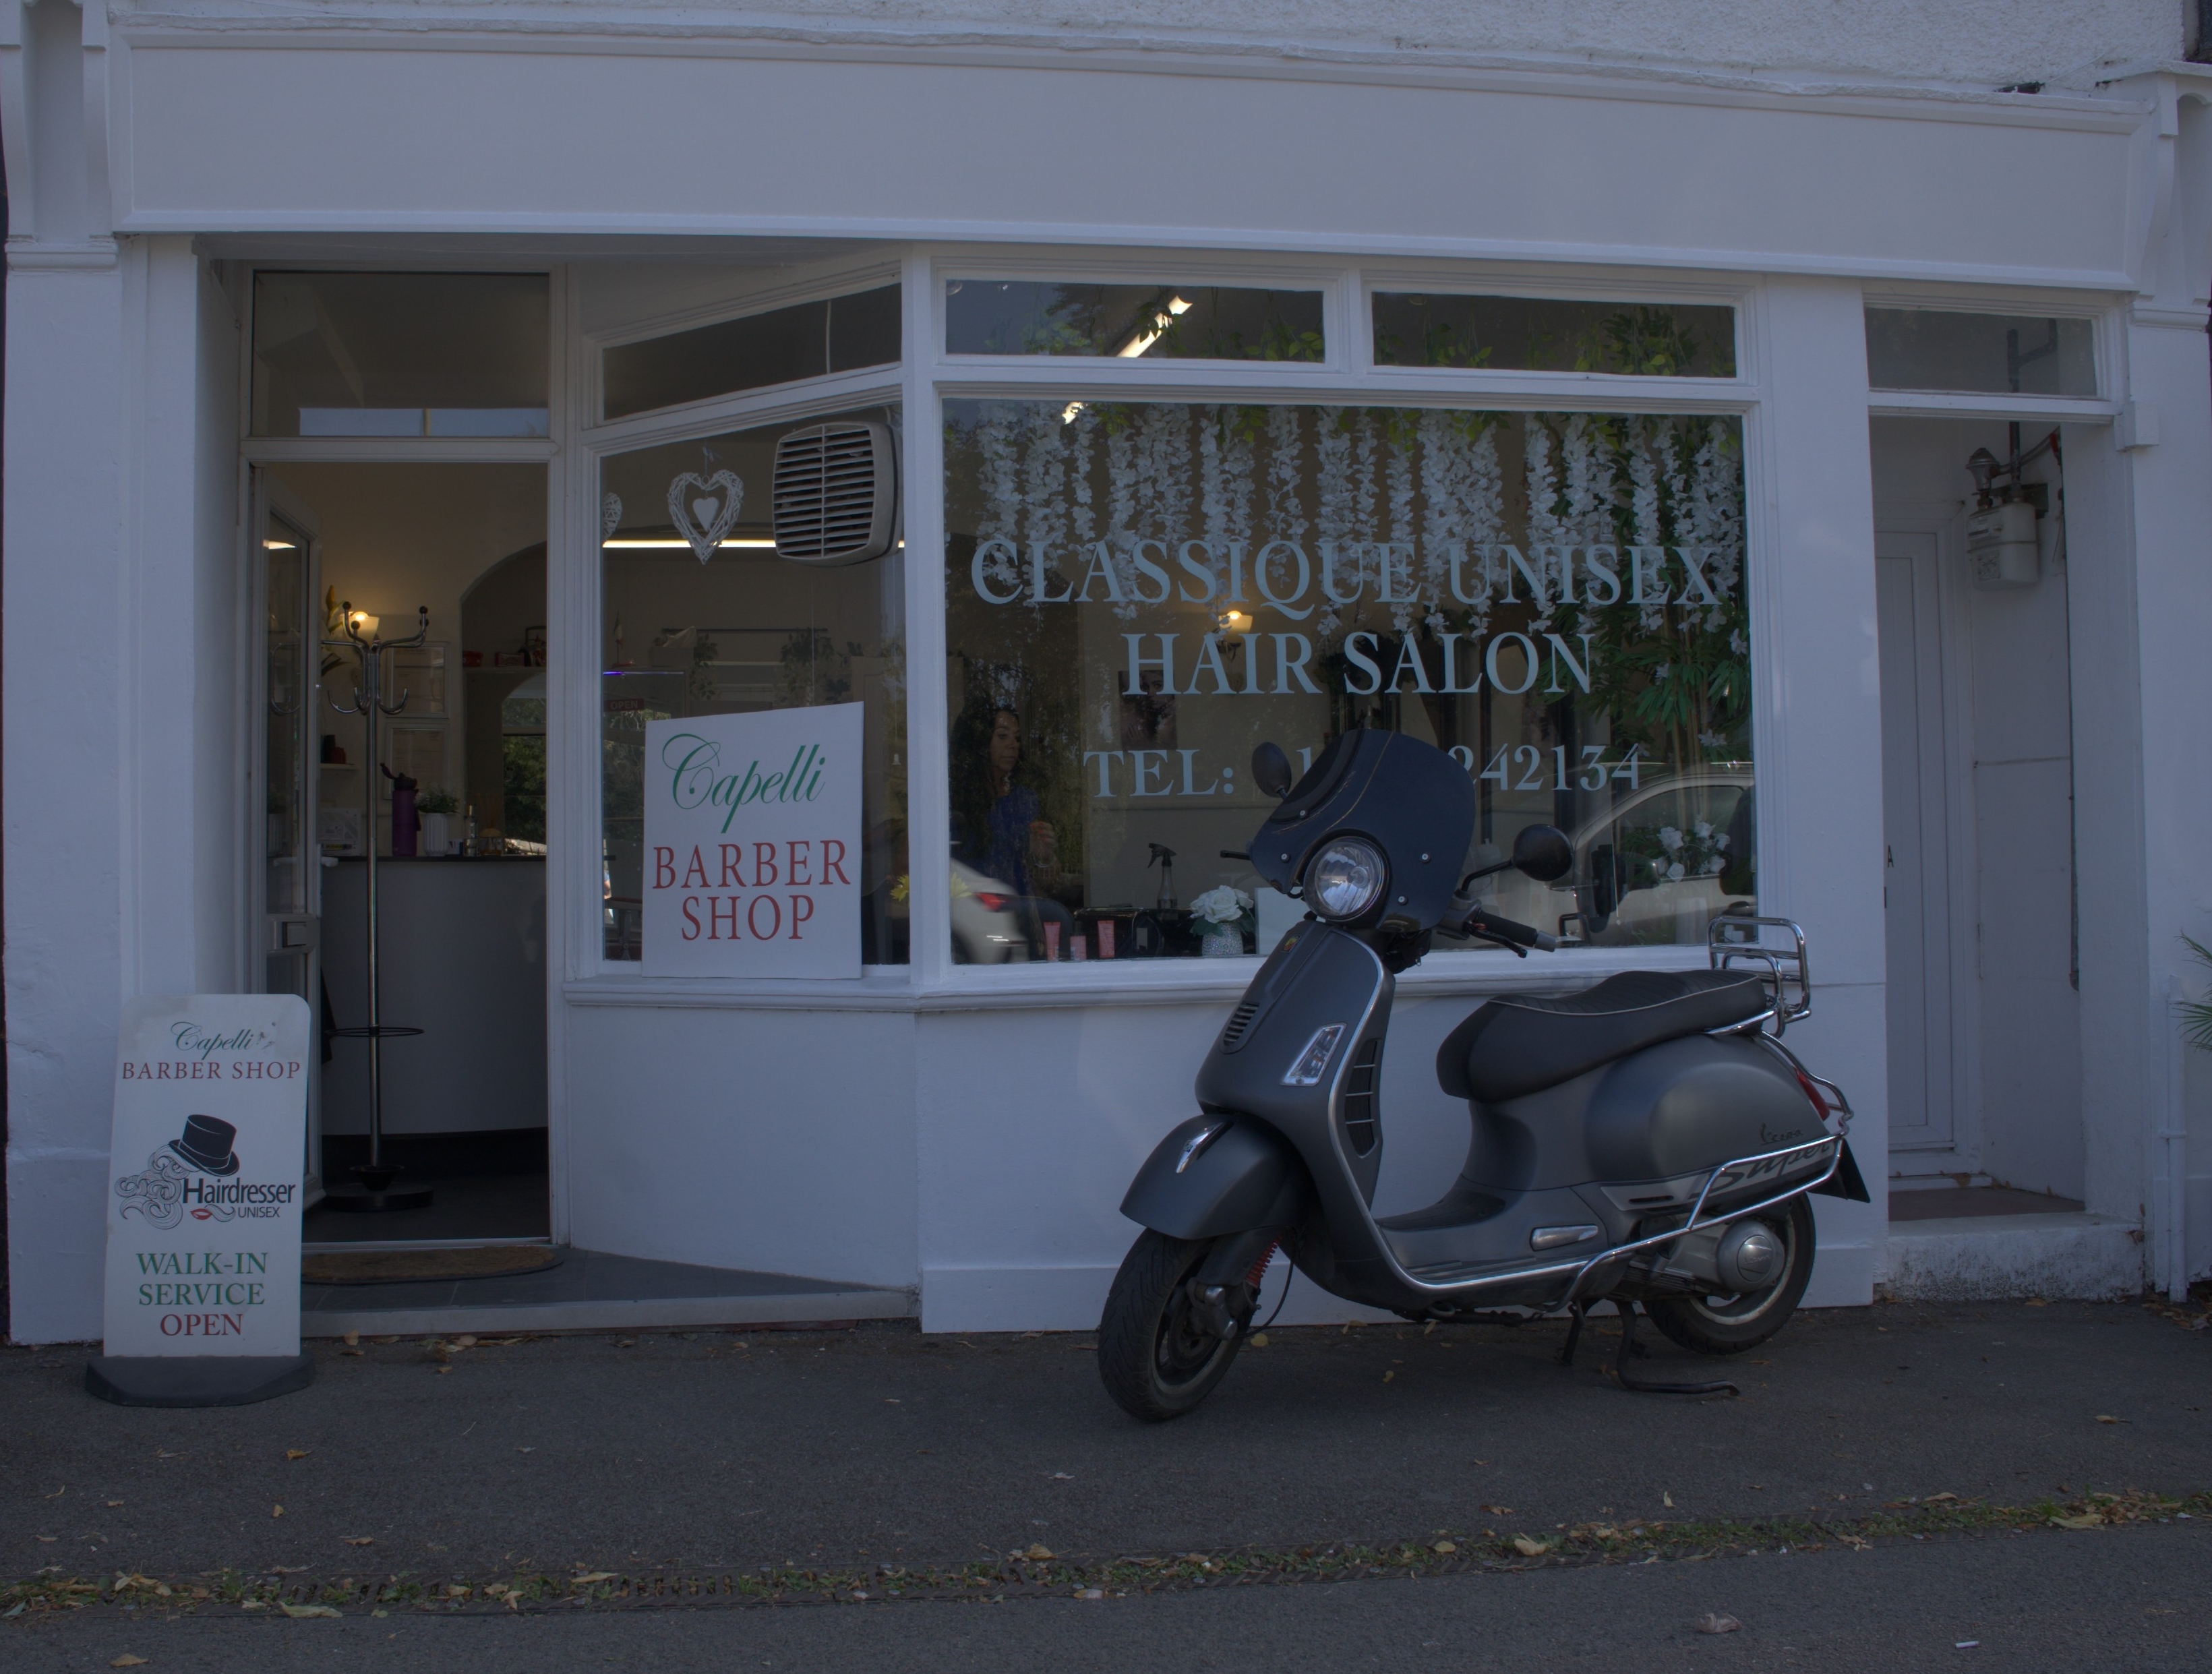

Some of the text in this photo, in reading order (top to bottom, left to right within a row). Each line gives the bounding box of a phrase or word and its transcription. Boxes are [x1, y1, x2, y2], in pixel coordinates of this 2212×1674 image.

[971, 539, 1723, 621] CLASSIQUE UNISEX
[1120, 632, 1596, 696] HAIR SALON
[609, 700, 638, 710] OPEN
[662, 734, 827, 834] Capelli
[1083, 748, 1235, 798] TEL:
[653, 839, 851, 889] BARBER
[682, 895, 814, 941] SHOP
[171, 1021, 254, 1060] Capelli
[123, 1061, 301, 1080] BARBER SHOP
[183, 1177, 296, 1204] Hairdresser
[237, 1207, 280, 1218] UNISEX
[136, 1253, 268, 1275] WALK-IN
[139, 1284, 265, 1306] SERVICE
[160, 1314, 243, 1336] OPEN
